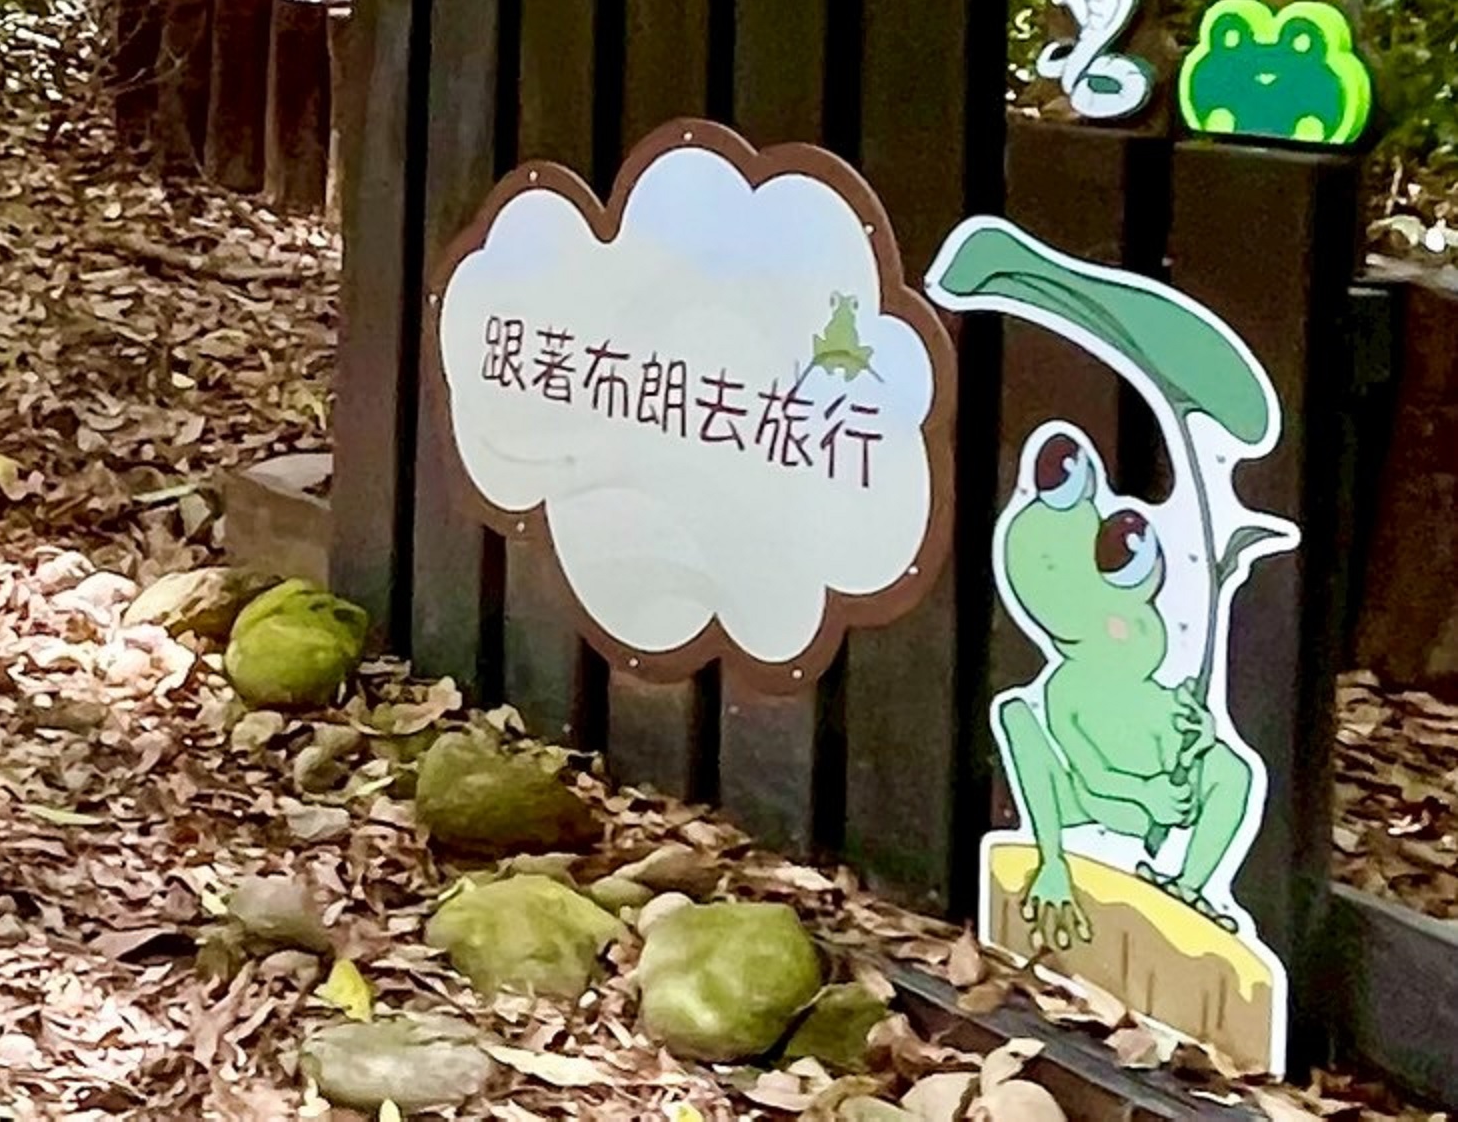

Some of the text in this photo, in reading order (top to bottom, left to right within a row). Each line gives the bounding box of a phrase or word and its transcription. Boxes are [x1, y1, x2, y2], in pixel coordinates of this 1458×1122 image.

[481, 315, 883, 488] 跟著布朗去旅行
